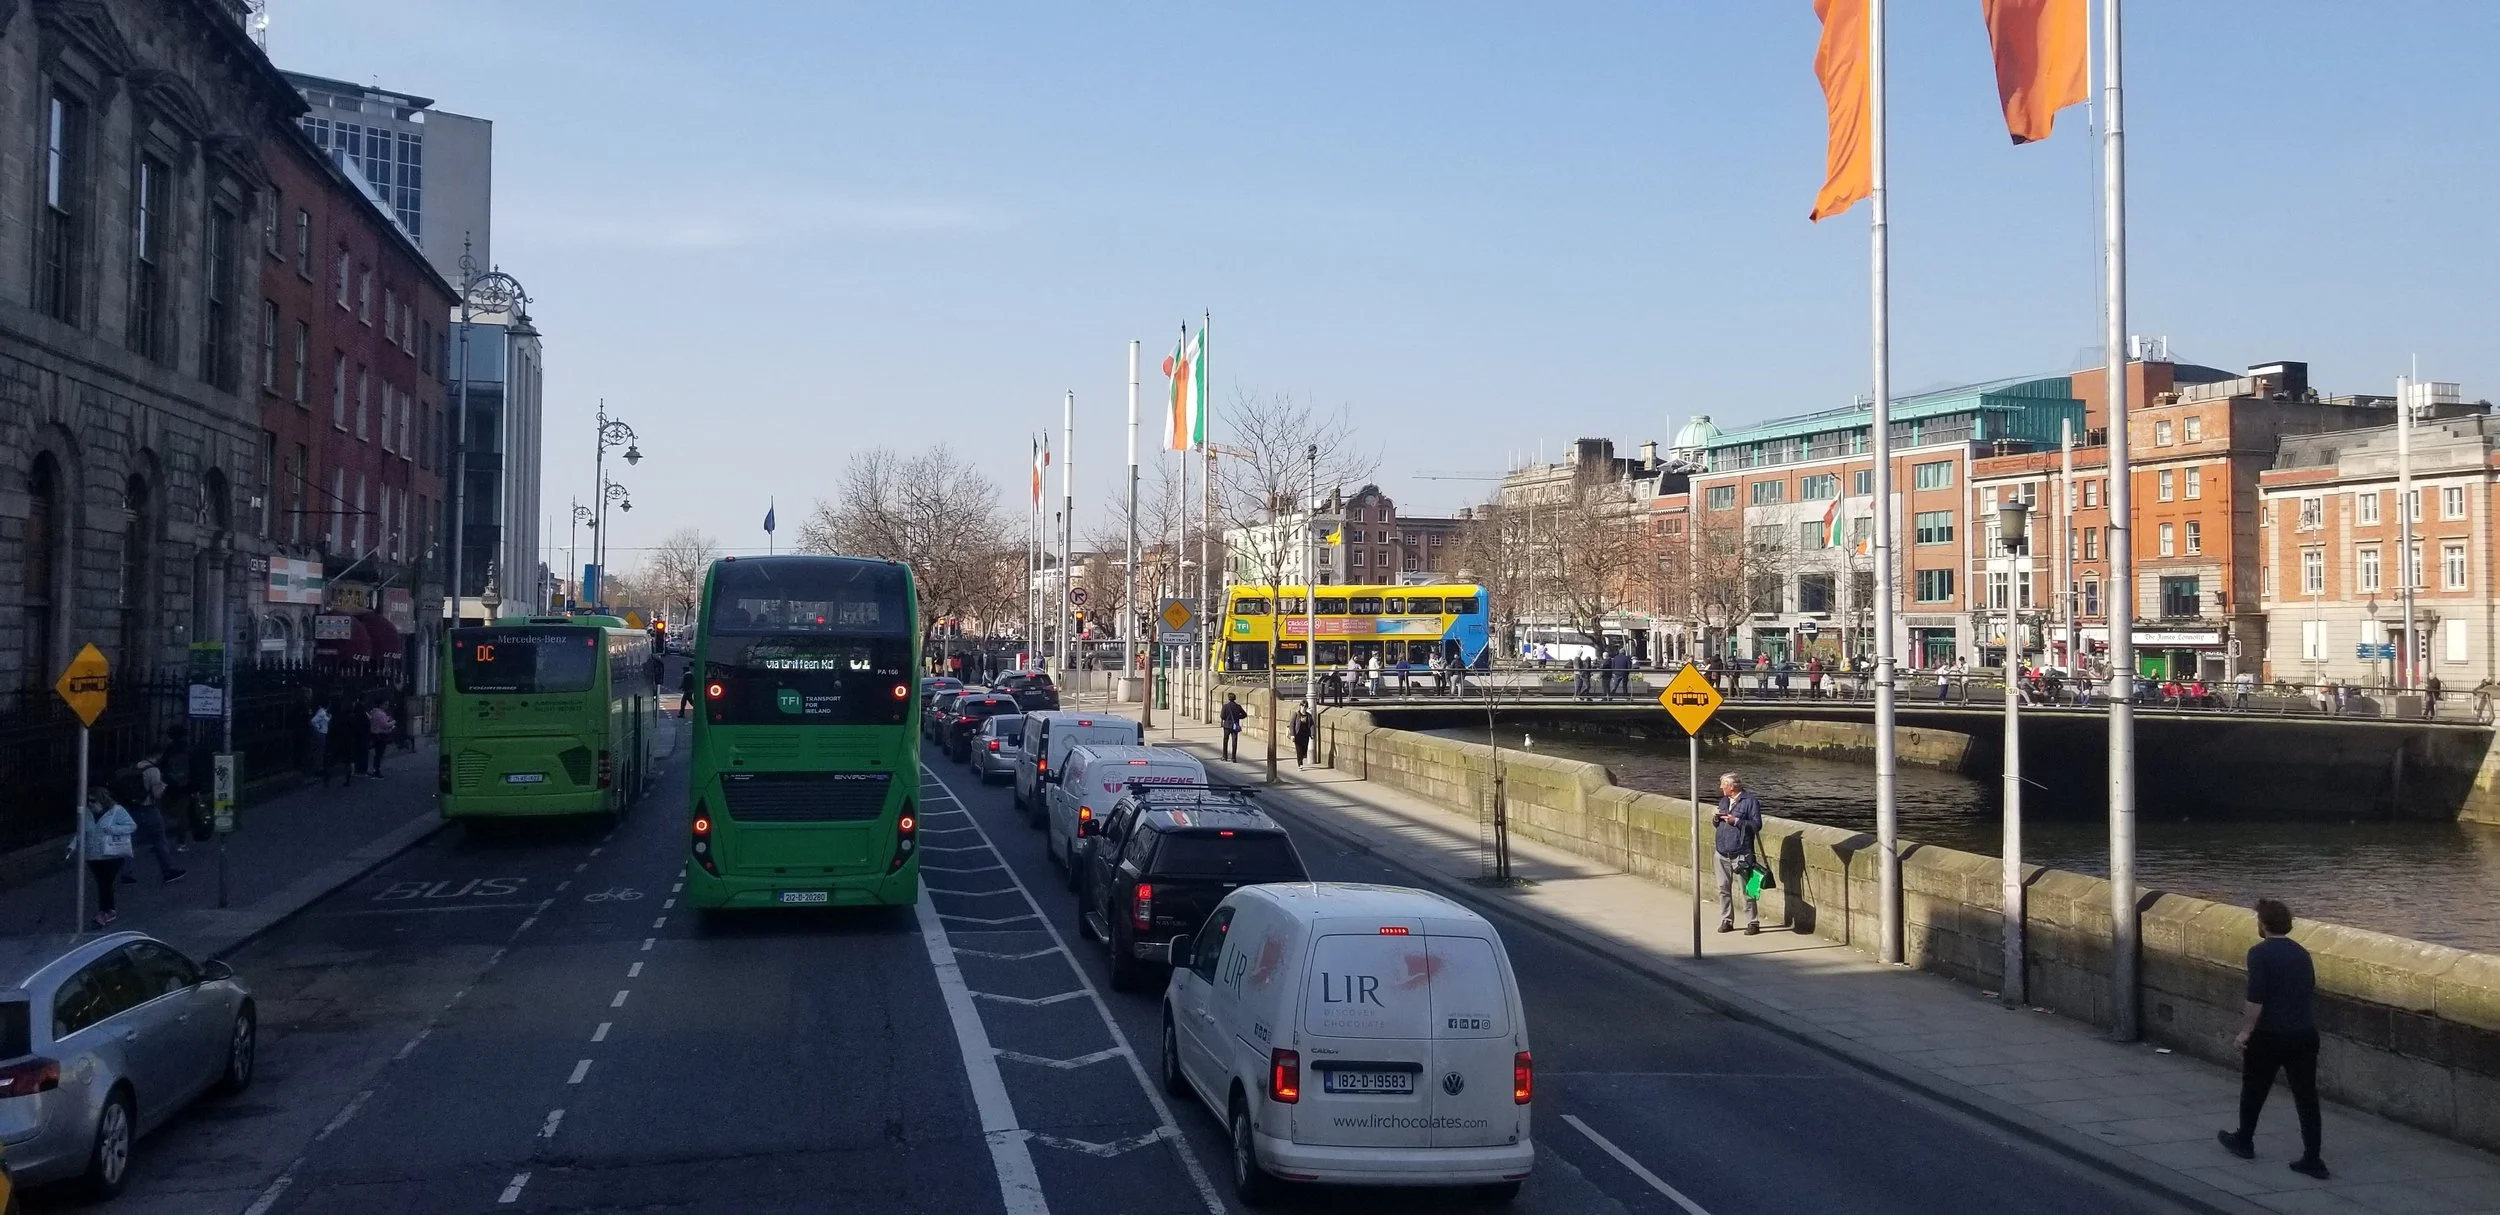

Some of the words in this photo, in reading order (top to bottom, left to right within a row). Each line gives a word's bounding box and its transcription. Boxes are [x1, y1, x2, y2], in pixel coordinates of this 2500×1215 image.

[498, 634, 567, 644] Mercedes-Benz
[477, 645, 495, 662] DC
[780, 696, 799, 705] TFI
[1127, 776, 1194, 784] STEPHENS
[372, 878, 528, 900] BUS
[1223, 942, 1248, 1000] LIR
[1321, 972, 1386, 1008] LIR
[1324, 1009, 1376, 1017] DISCOVER
[1324, 1020, 1385, 1029] CHOCOLATE
[1337, 1074, 1406, 1089] 182-D-19583
[1333, 1113, 1488, 1129] www.lirchocolates.com
